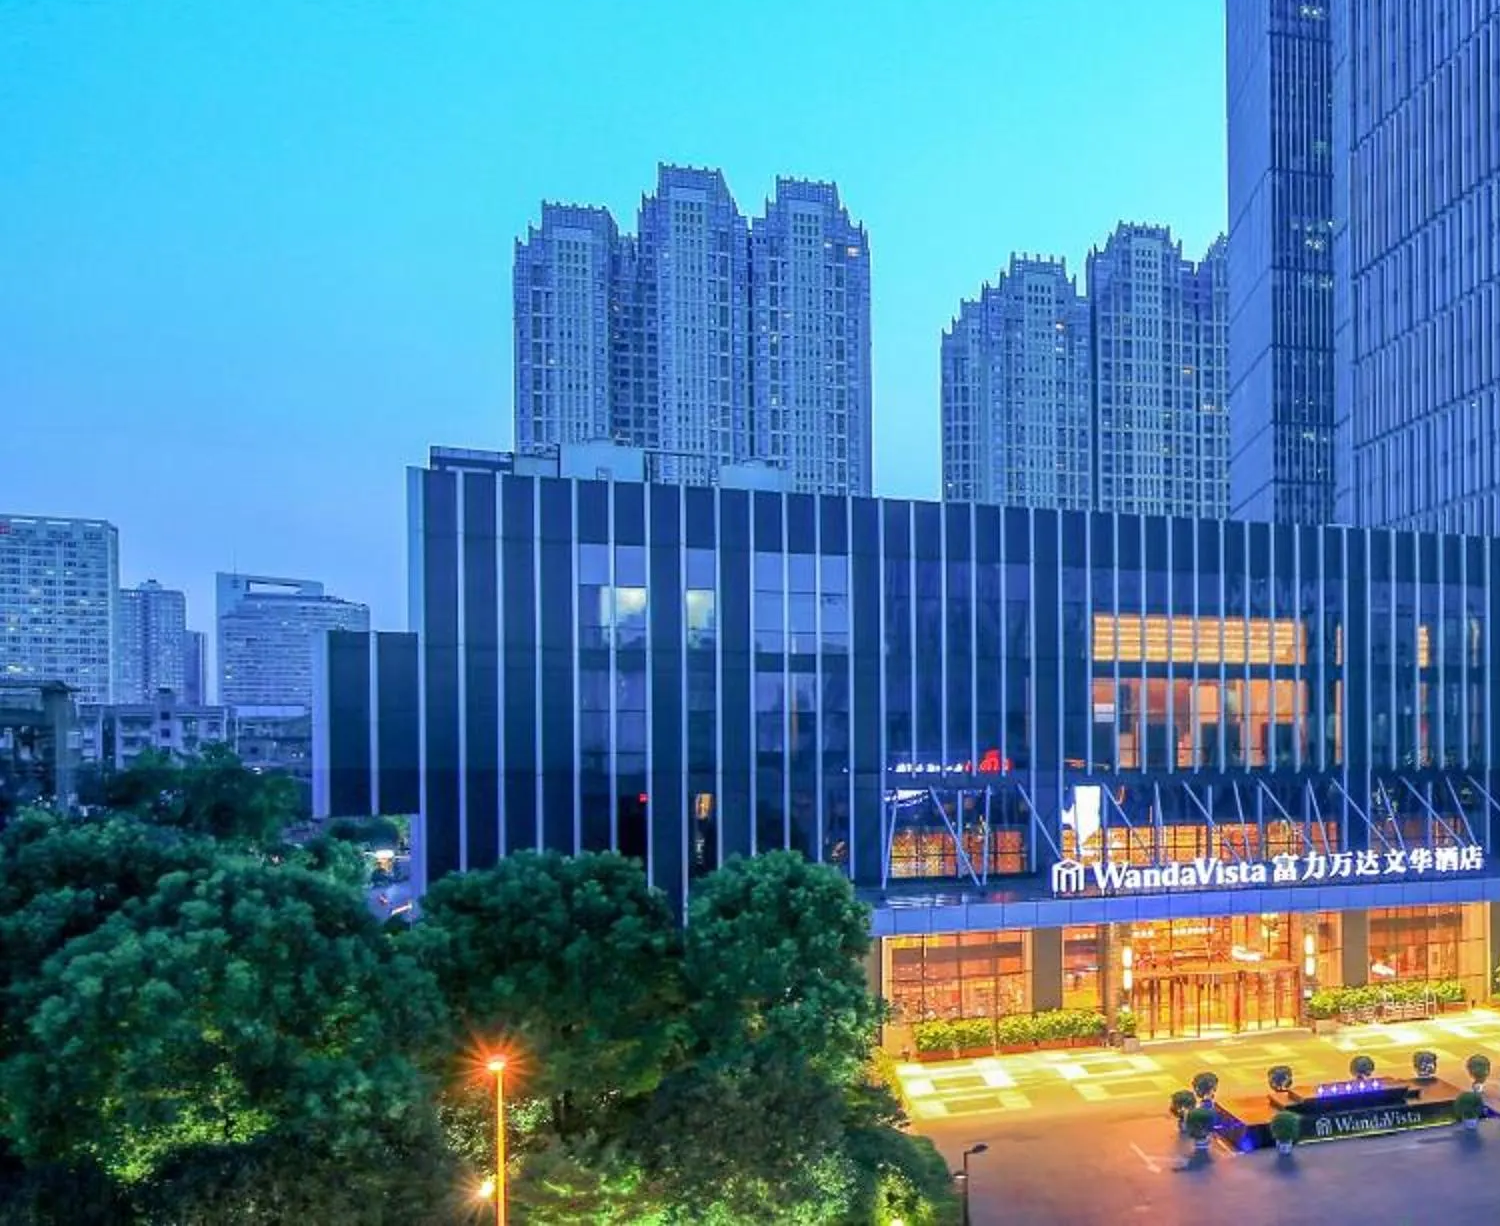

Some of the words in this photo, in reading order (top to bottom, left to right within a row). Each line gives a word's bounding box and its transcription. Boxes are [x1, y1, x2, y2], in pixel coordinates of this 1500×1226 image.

[1093, 857, 1267, 890] WandaVista
[1272, 845, 1485, 882] 富力万达文华酒店
[1335, 1110, 1422, 1132] WandaVista
